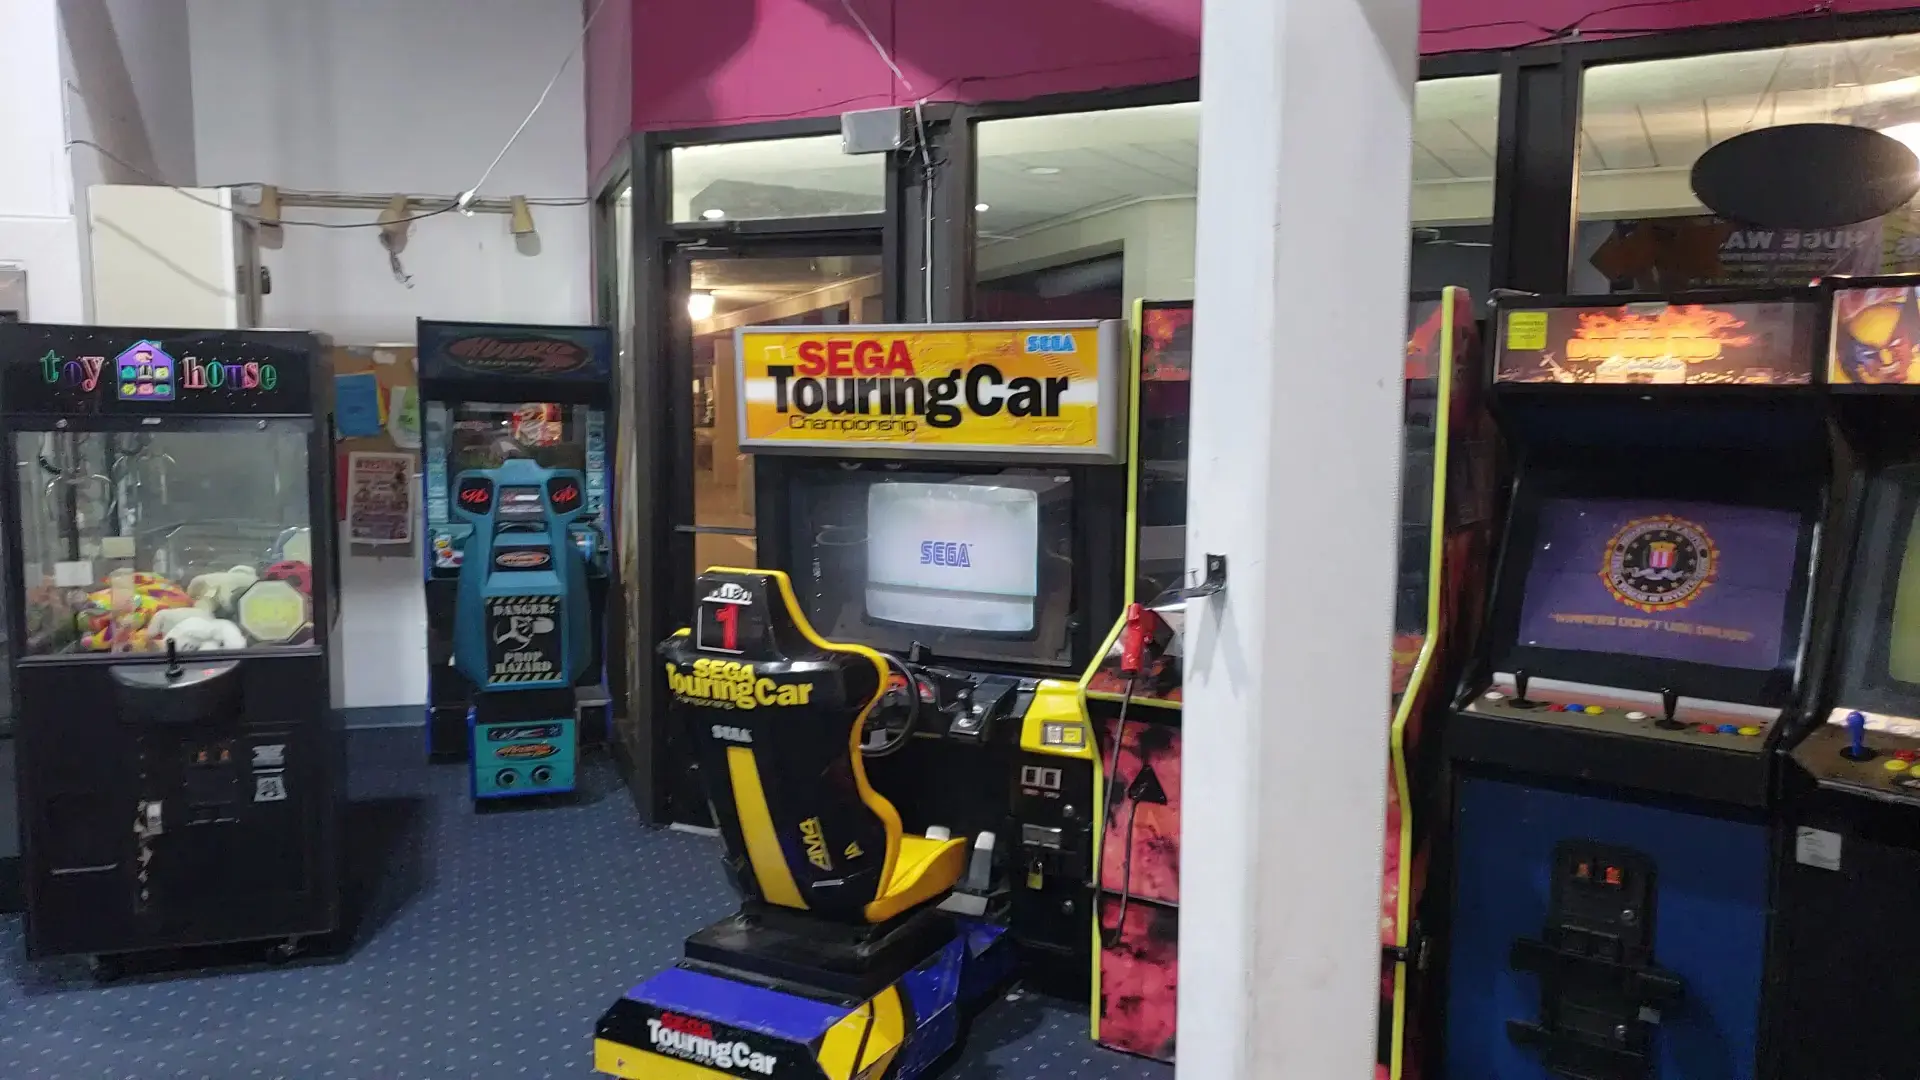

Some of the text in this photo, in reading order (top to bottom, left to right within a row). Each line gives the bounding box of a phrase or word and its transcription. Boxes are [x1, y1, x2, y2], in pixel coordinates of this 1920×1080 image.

[1024, 334, 1075, 352] SEGA
[40, 350, 278, 392] toy house
[797, 340, 915, 376] SEGA
[789, 415, 918, 434] Championship
[921, 541, 971, 567] SEGA
[715, 603, 739, 650] 1
[494, 661, 553, 675] HAZARD
[693, 658, 756, 684] SEGA
[661, 1012, 713, 1040] SEGA
